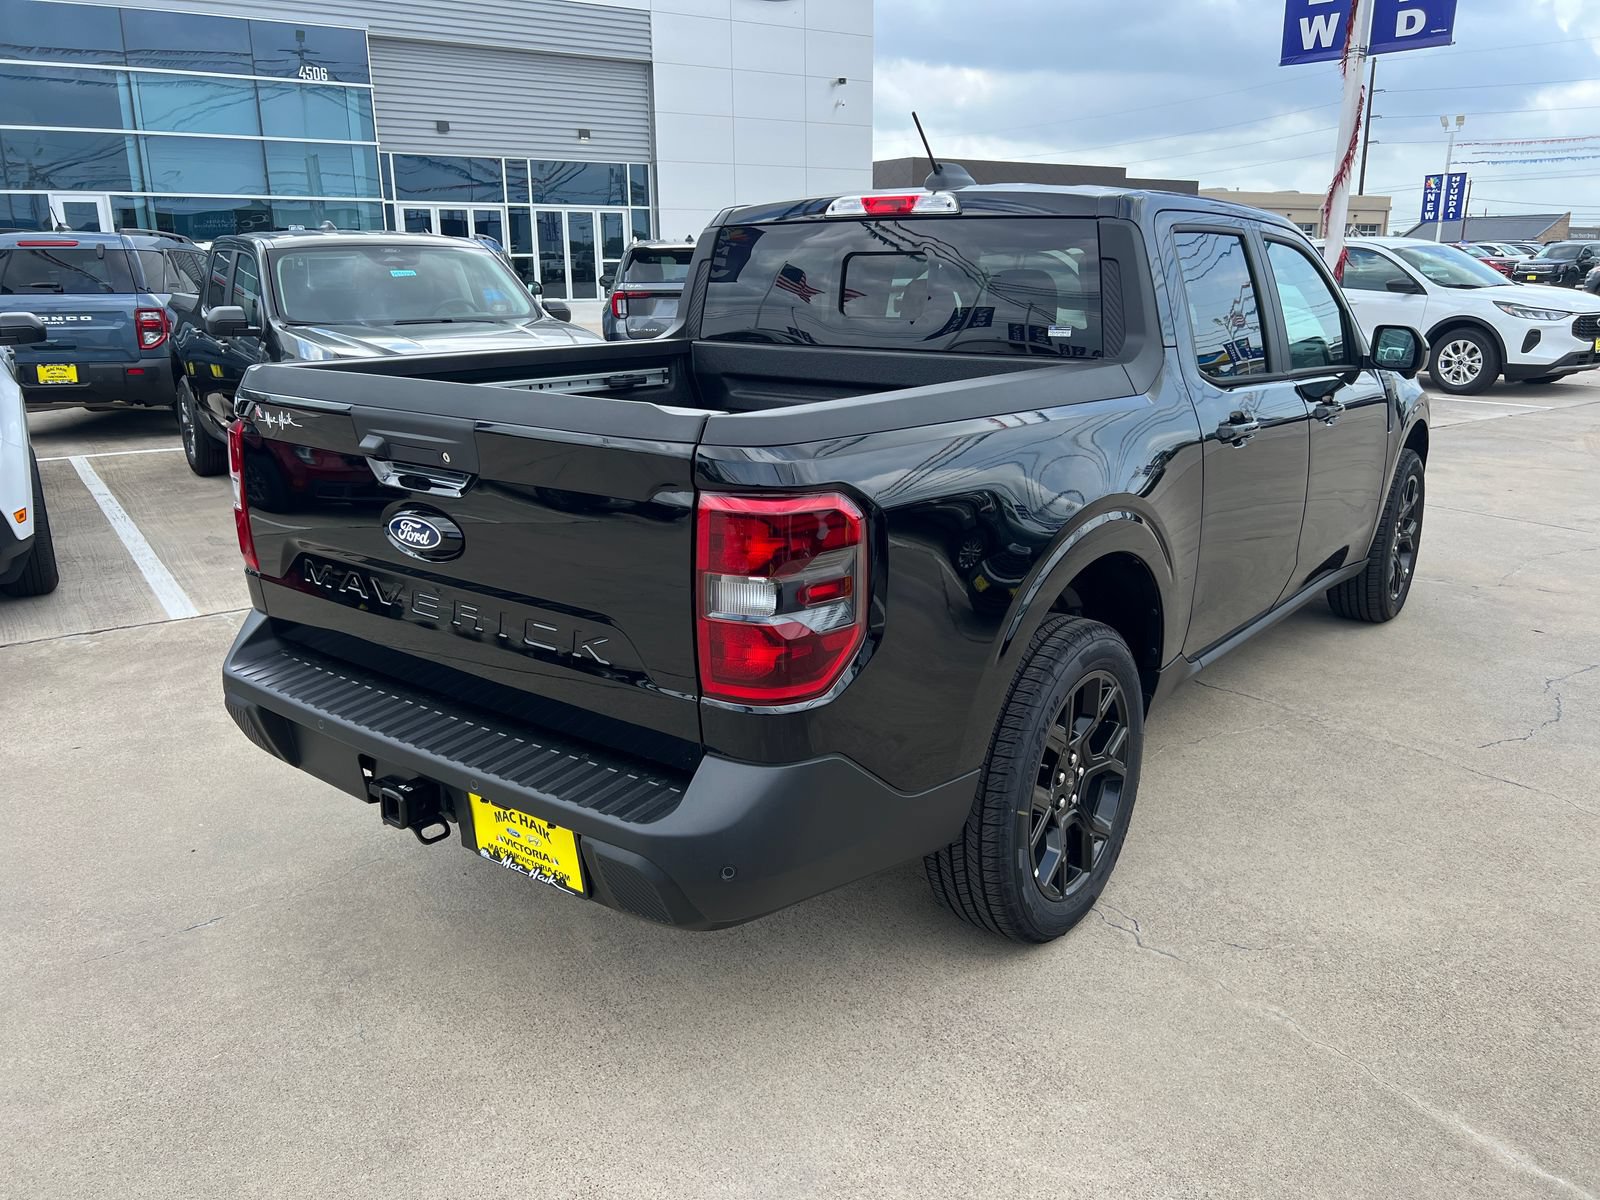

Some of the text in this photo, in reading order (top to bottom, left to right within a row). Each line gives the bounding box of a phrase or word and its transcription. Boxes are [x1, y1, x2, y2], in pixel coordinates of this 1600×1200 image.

[1300, 0, 1340, 50] W
[298, 65, 328, 81] 4506
[1424, 193, 1436, 220] NEW
[1447, 176, 1461, 219] HYUNDAI
[398, 520, 430, 545] Ford
[304, 558, 611, 665] MAVERICK
[494, 810, 552, 844] MAC HAIK
[502, 836, 551, 863] VICTORIA
[497, 855, 528, 875] Mac
